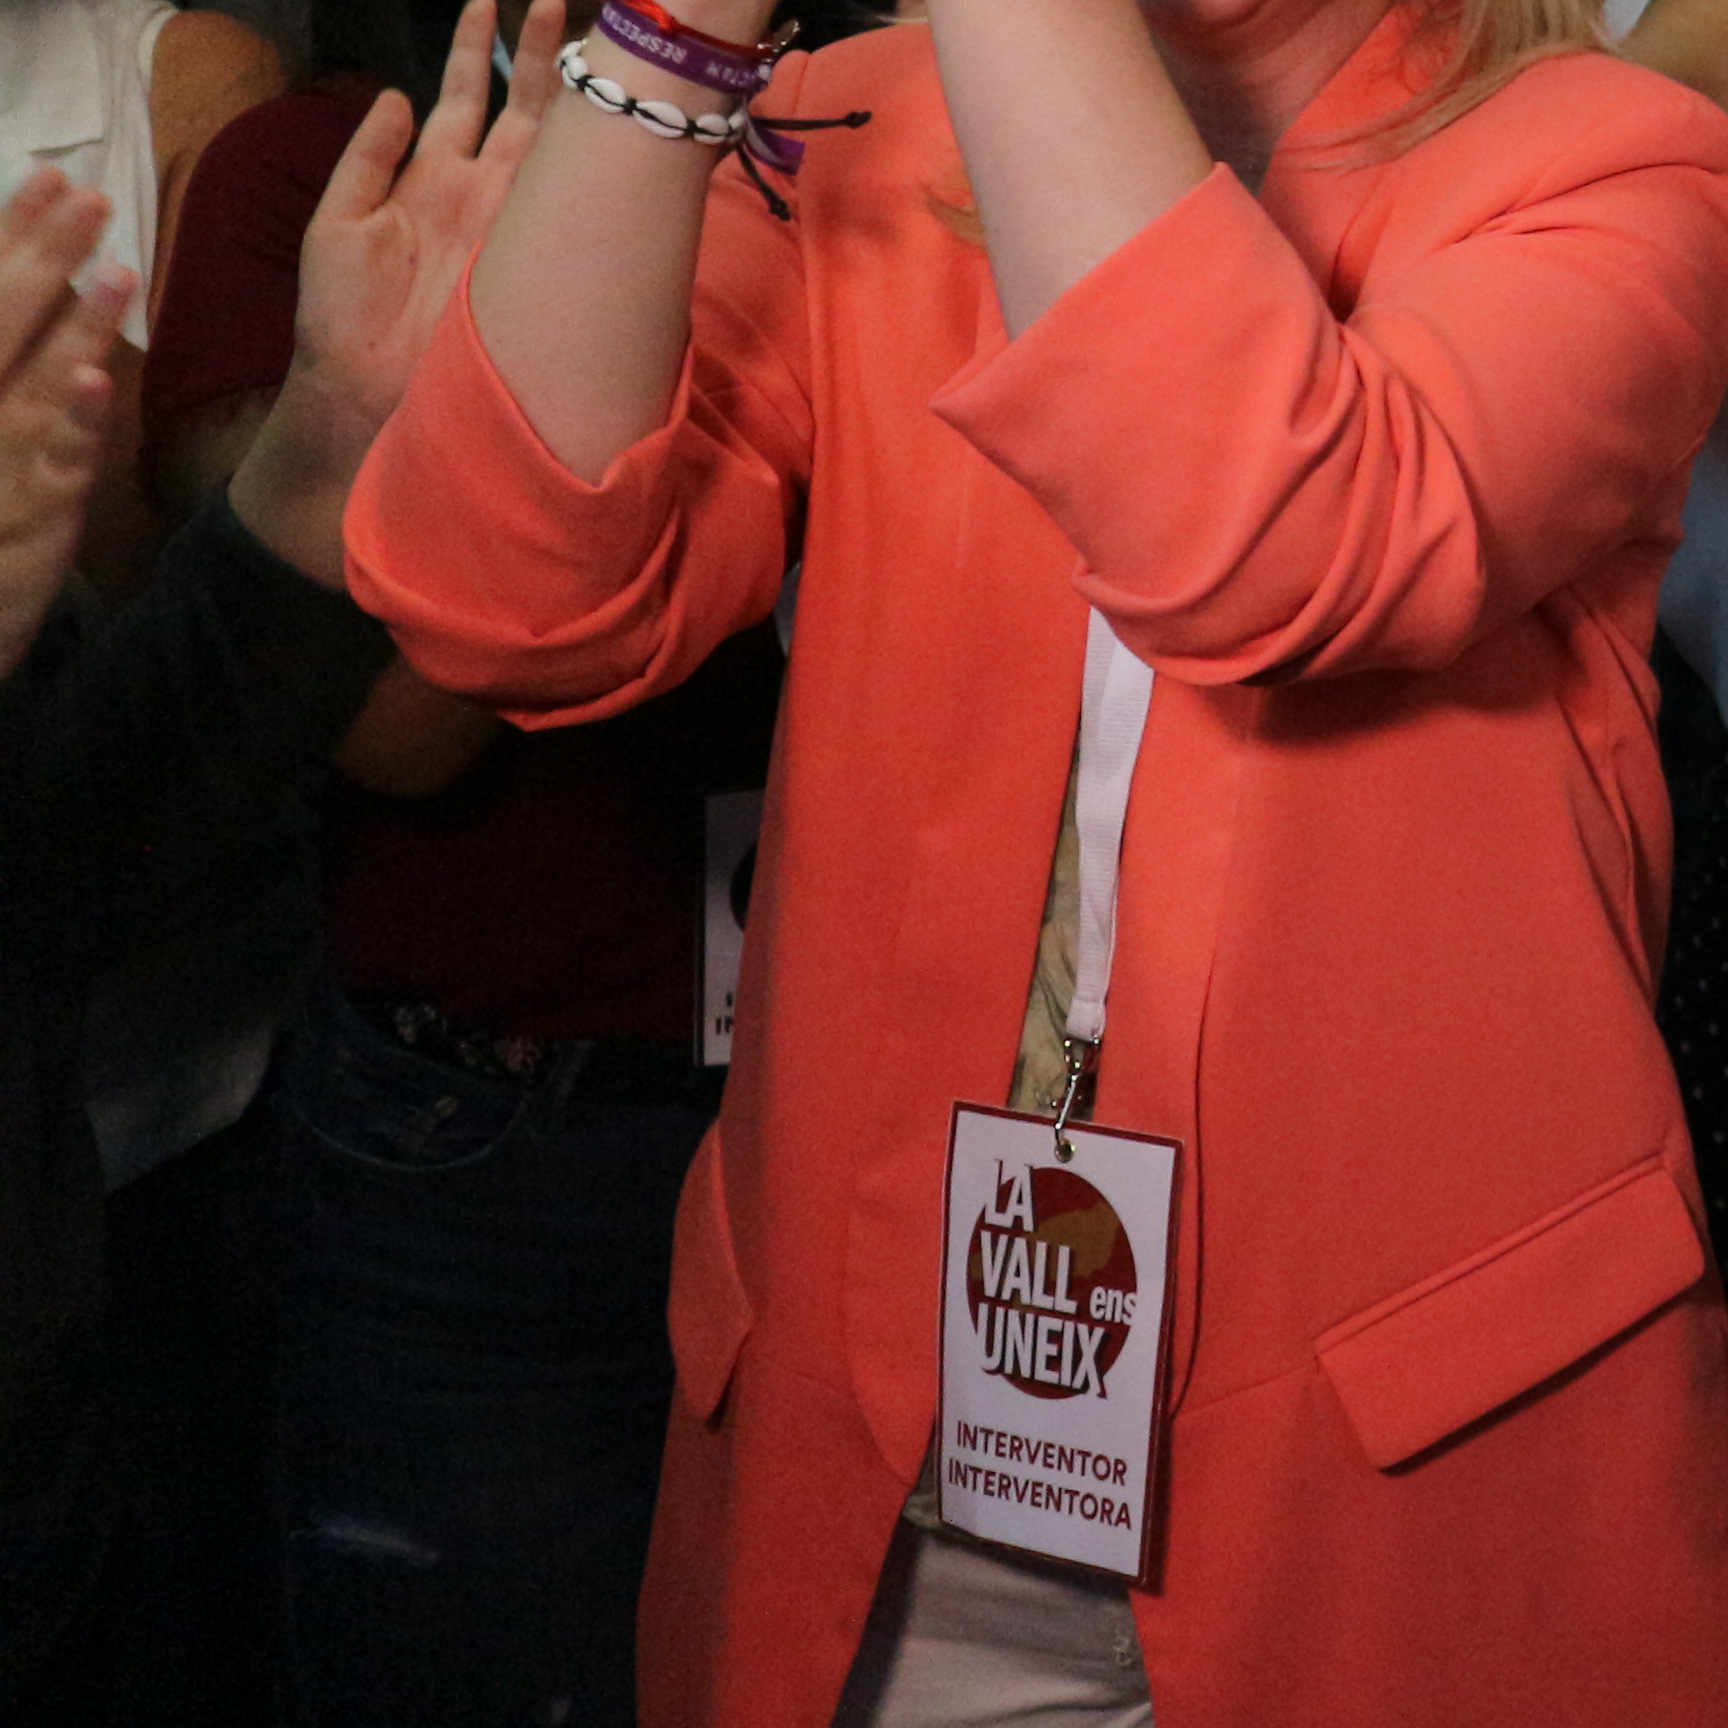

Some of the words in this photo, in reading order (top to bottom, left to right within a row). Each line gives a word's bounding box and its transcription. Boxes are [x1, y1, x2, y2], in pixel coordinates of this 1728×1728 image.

[982, 1158, 1035, 1232] LA
[979, 1230, 1079, 1313] VALL
[1089, 1283, 1137, 1327] ens
[977, 1303, 1108, 1399] UNEIX
[955, 1419, 1128, 1488] INTERVENTOR
[948, 1458, 1133, 1531] INTERVENTORA
